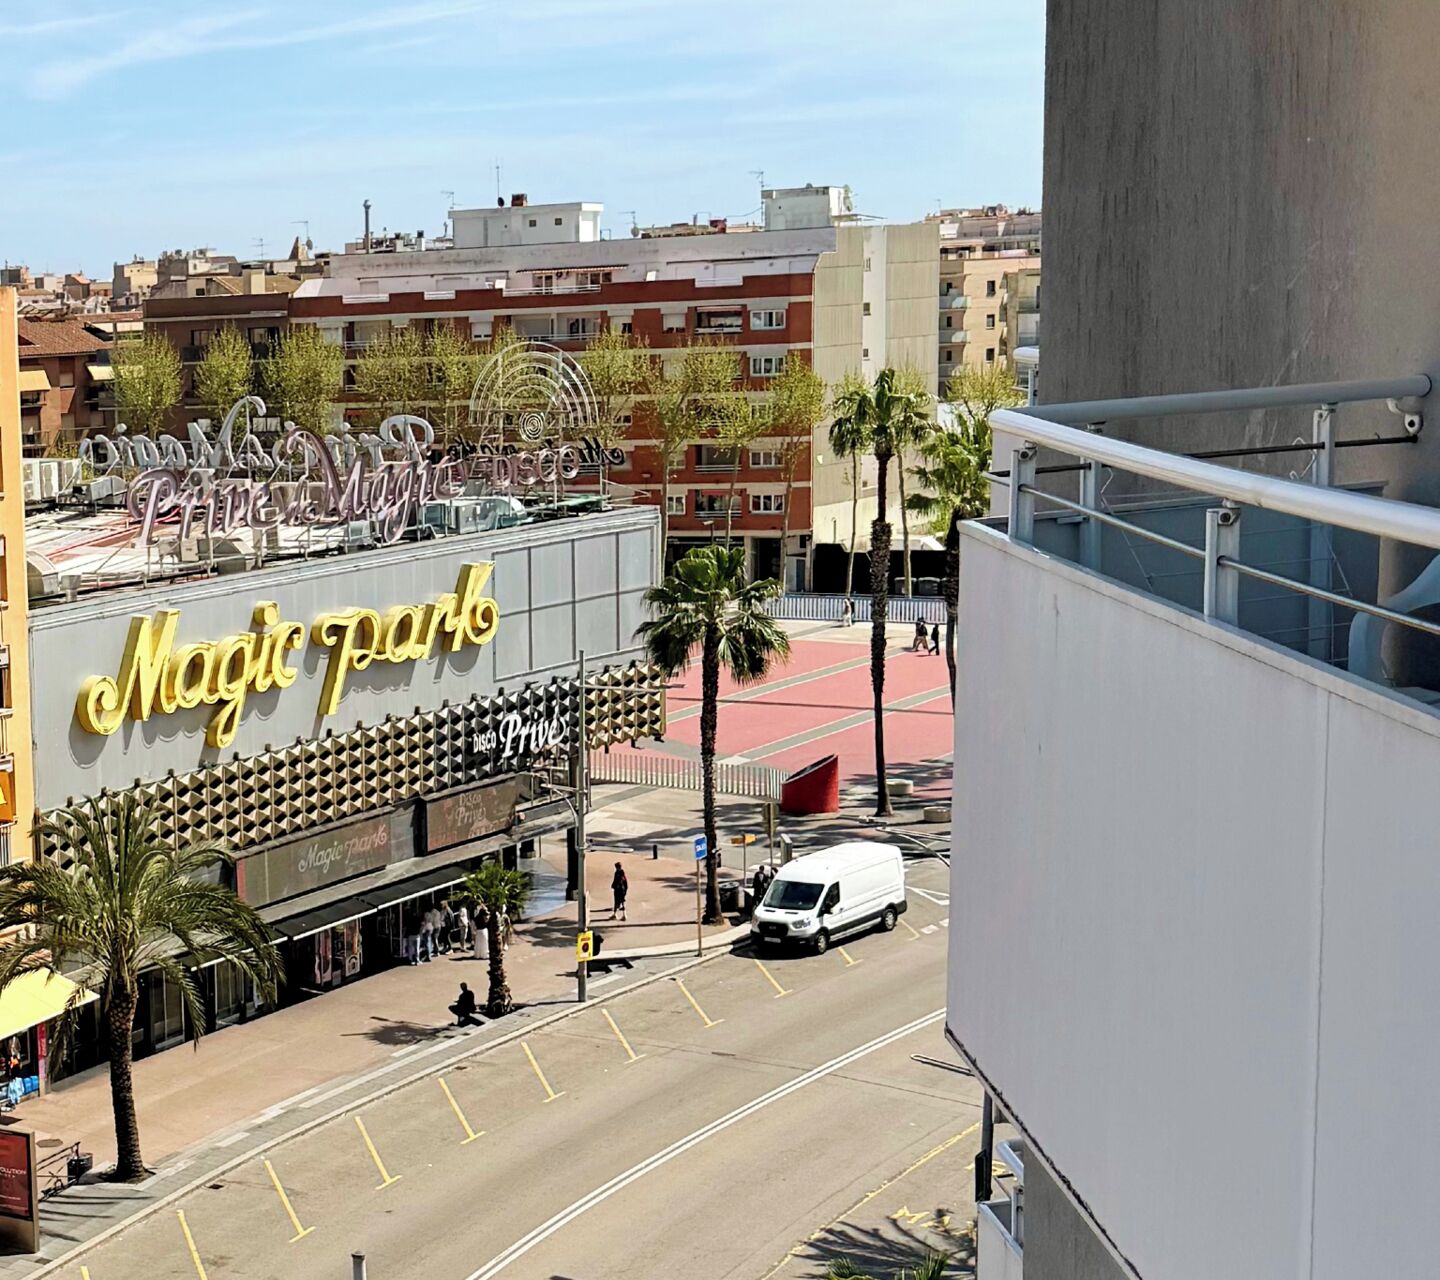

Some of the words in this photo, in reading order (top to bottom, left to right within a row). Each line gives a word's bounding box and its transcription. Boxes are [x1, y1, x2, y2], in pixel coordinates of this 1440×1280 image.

[287, 425, 469, 544] Magic
[76, 599, 306, 749] Magic
[472, 731, 497, 753] DISCO
[498, 702, 566, 759] Privé
[297, 842, 344, 874] Magic
